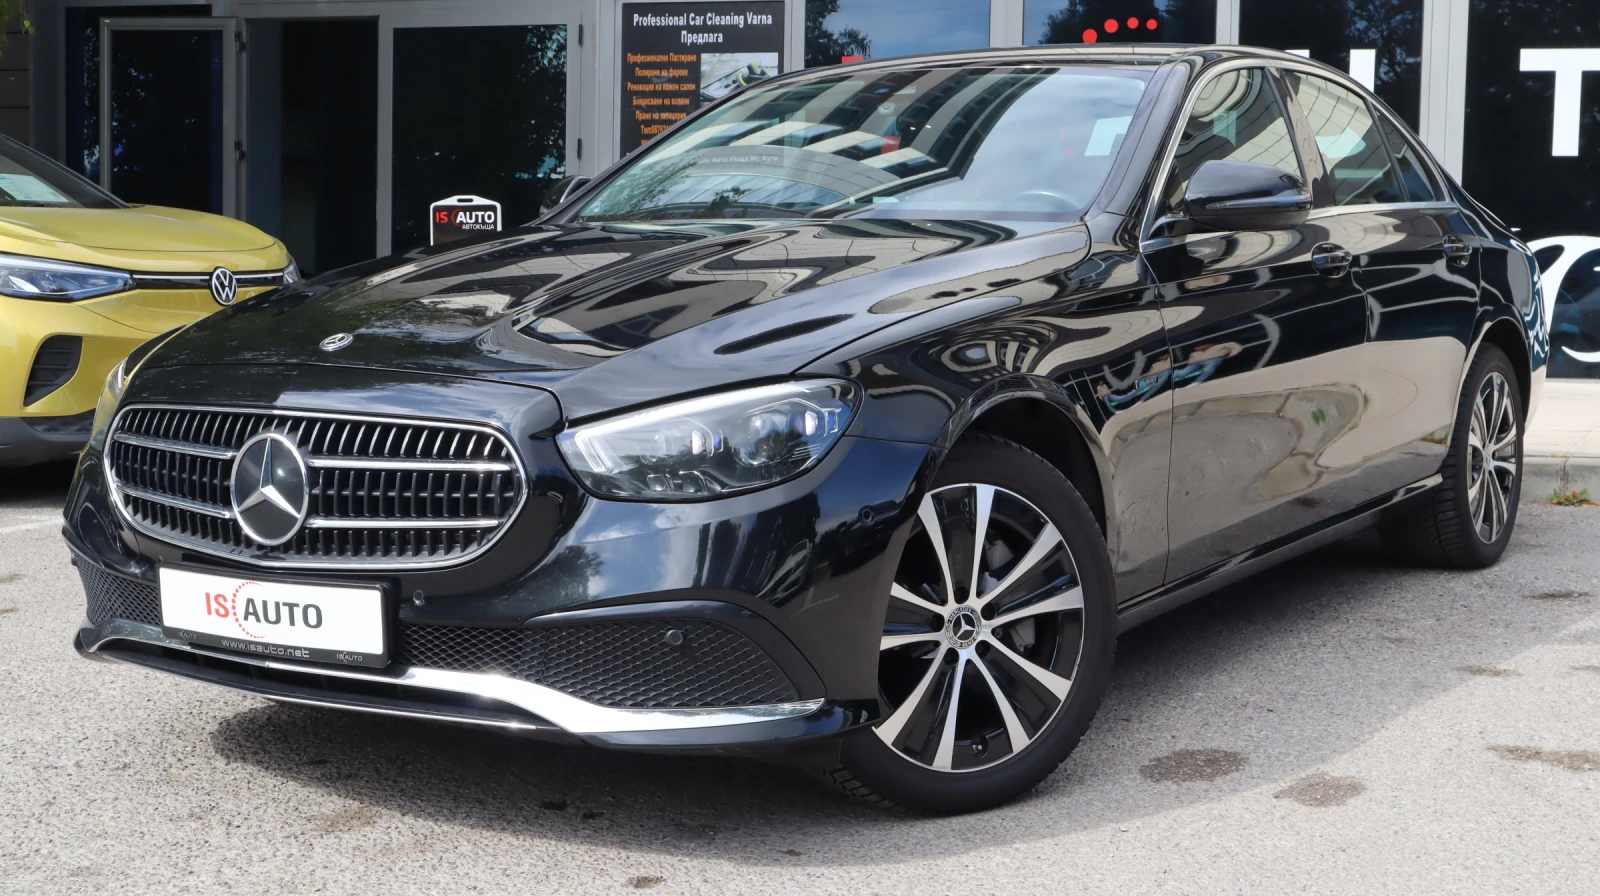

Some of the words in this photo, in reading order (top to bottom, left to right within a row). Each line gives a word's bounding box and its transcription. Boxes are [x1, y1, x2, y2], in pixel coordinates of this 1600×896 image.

[633, 13, 687, 27] Professional
[689, 12, 704, 26] Car
[706, 12, 745, 28] Cleaning
[746, 11, 772, 25] Varna
[681, 30, 723, 46] Предлага
[669, 67, 689, 78] фарове
[655, 83, 662, 91] на
[680, 83, 696, 91] салон
[635, 110, 652, 121] Пране
[652, 112, 659, 120] на
[435, 211, 449, 224] IS
[455, 211, 495, 224] AUTO
[205, 592, 230, 619] IS
[243, 597, 323, 629] AUTO
[221, 639, 310, 658] www.isauto.net
